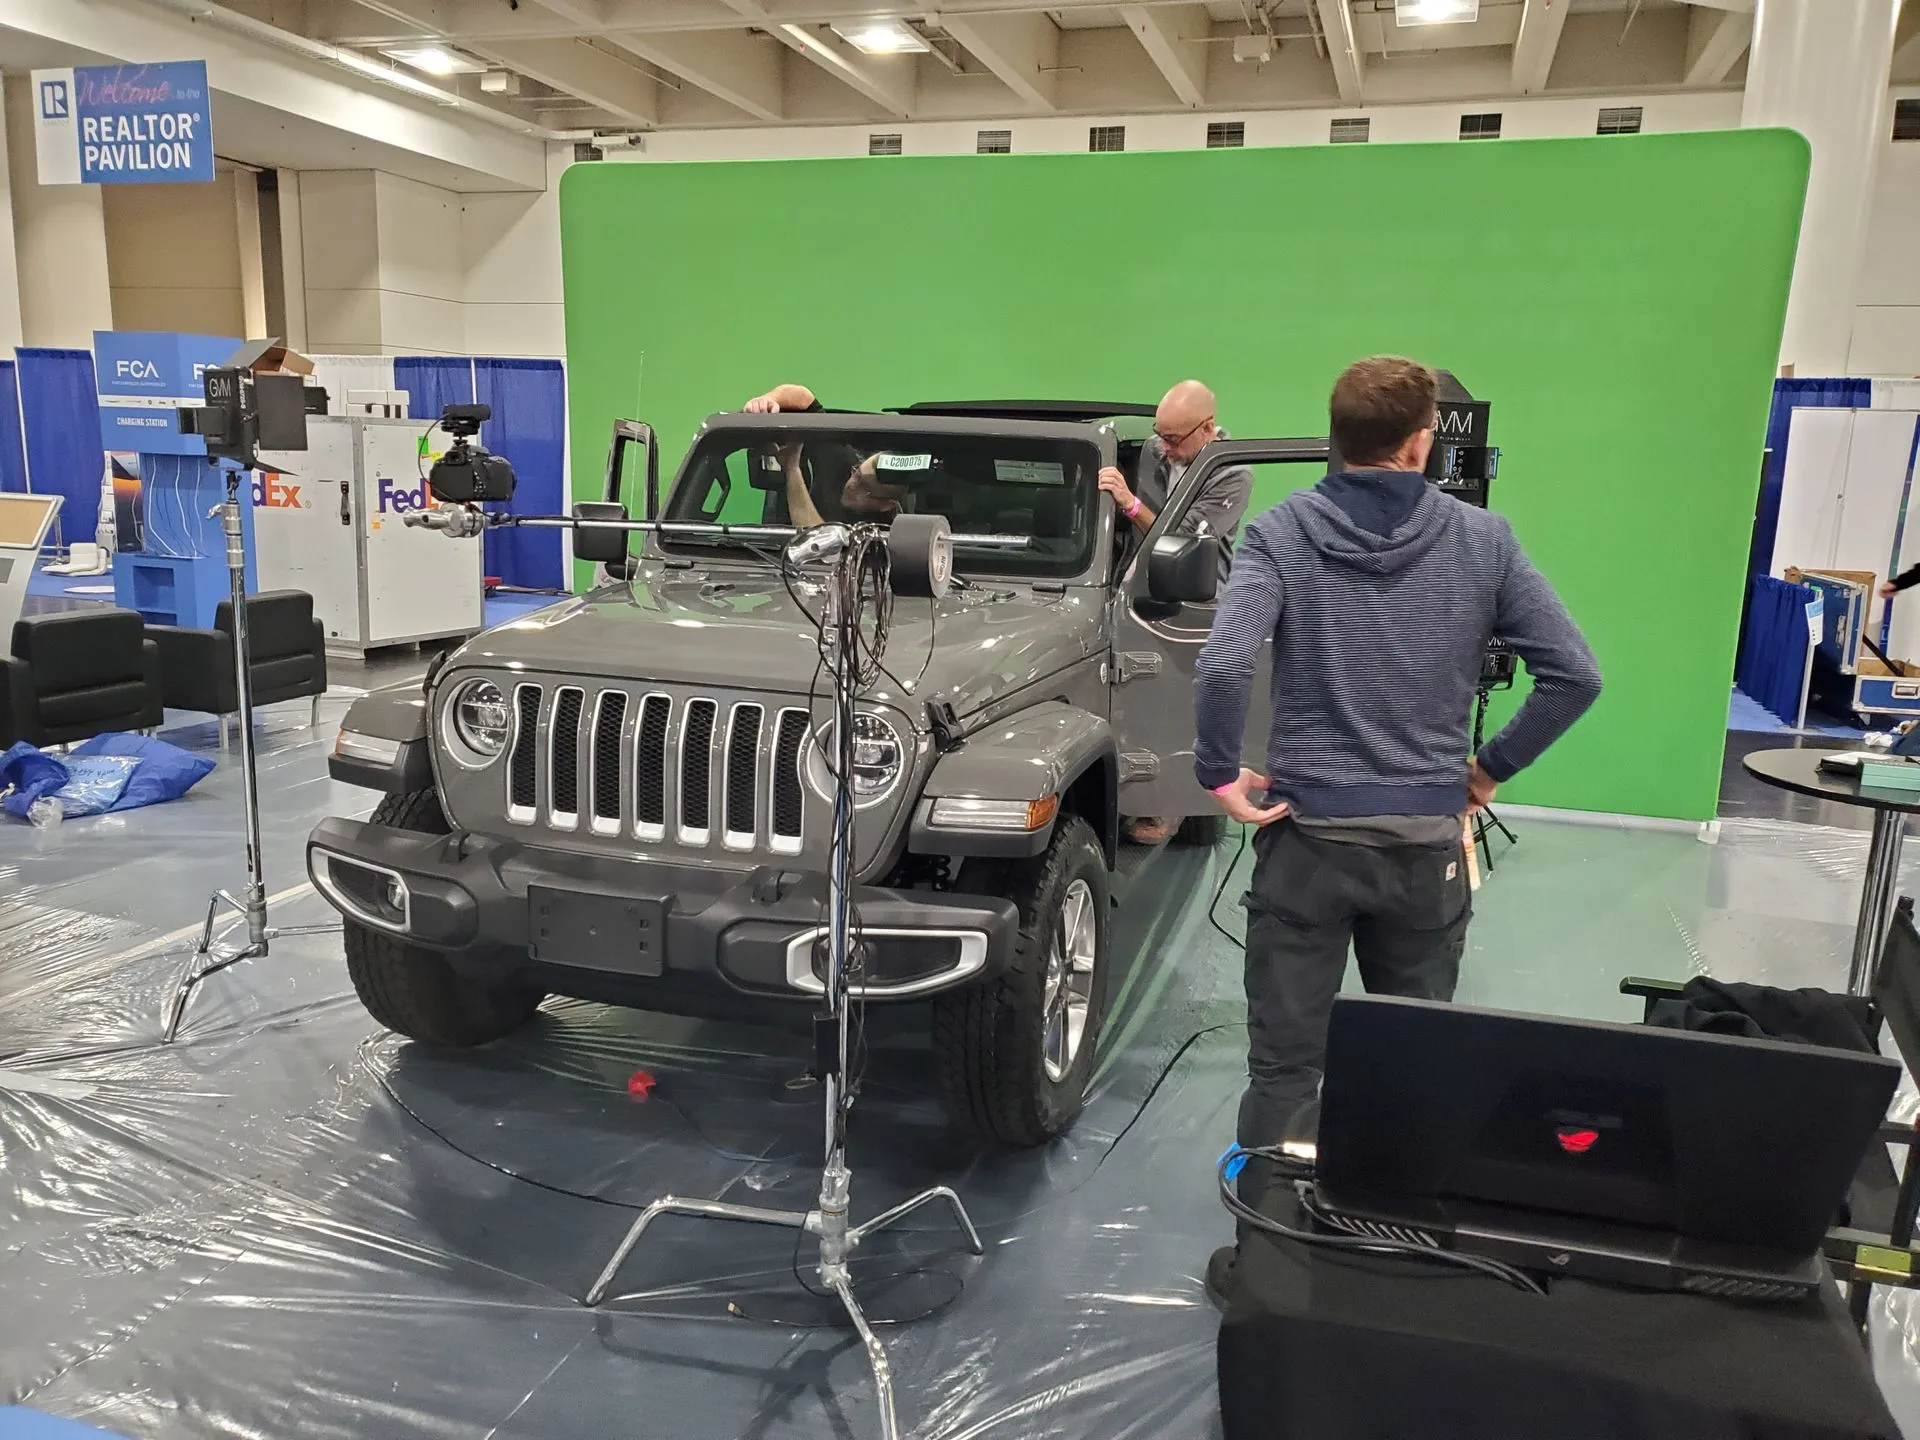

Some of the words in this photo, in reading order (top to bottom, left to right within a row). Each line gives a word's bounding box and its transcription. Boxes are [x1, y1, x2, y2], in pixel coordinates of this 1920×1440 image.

[85, 142, 191, 171] PAVILION
[116, 360, 160, 379] FCA
[209, 378, 232, 398] GVM
[1434, 410, 1473, 434] VM
[252, 472, 302, 509] dEx
